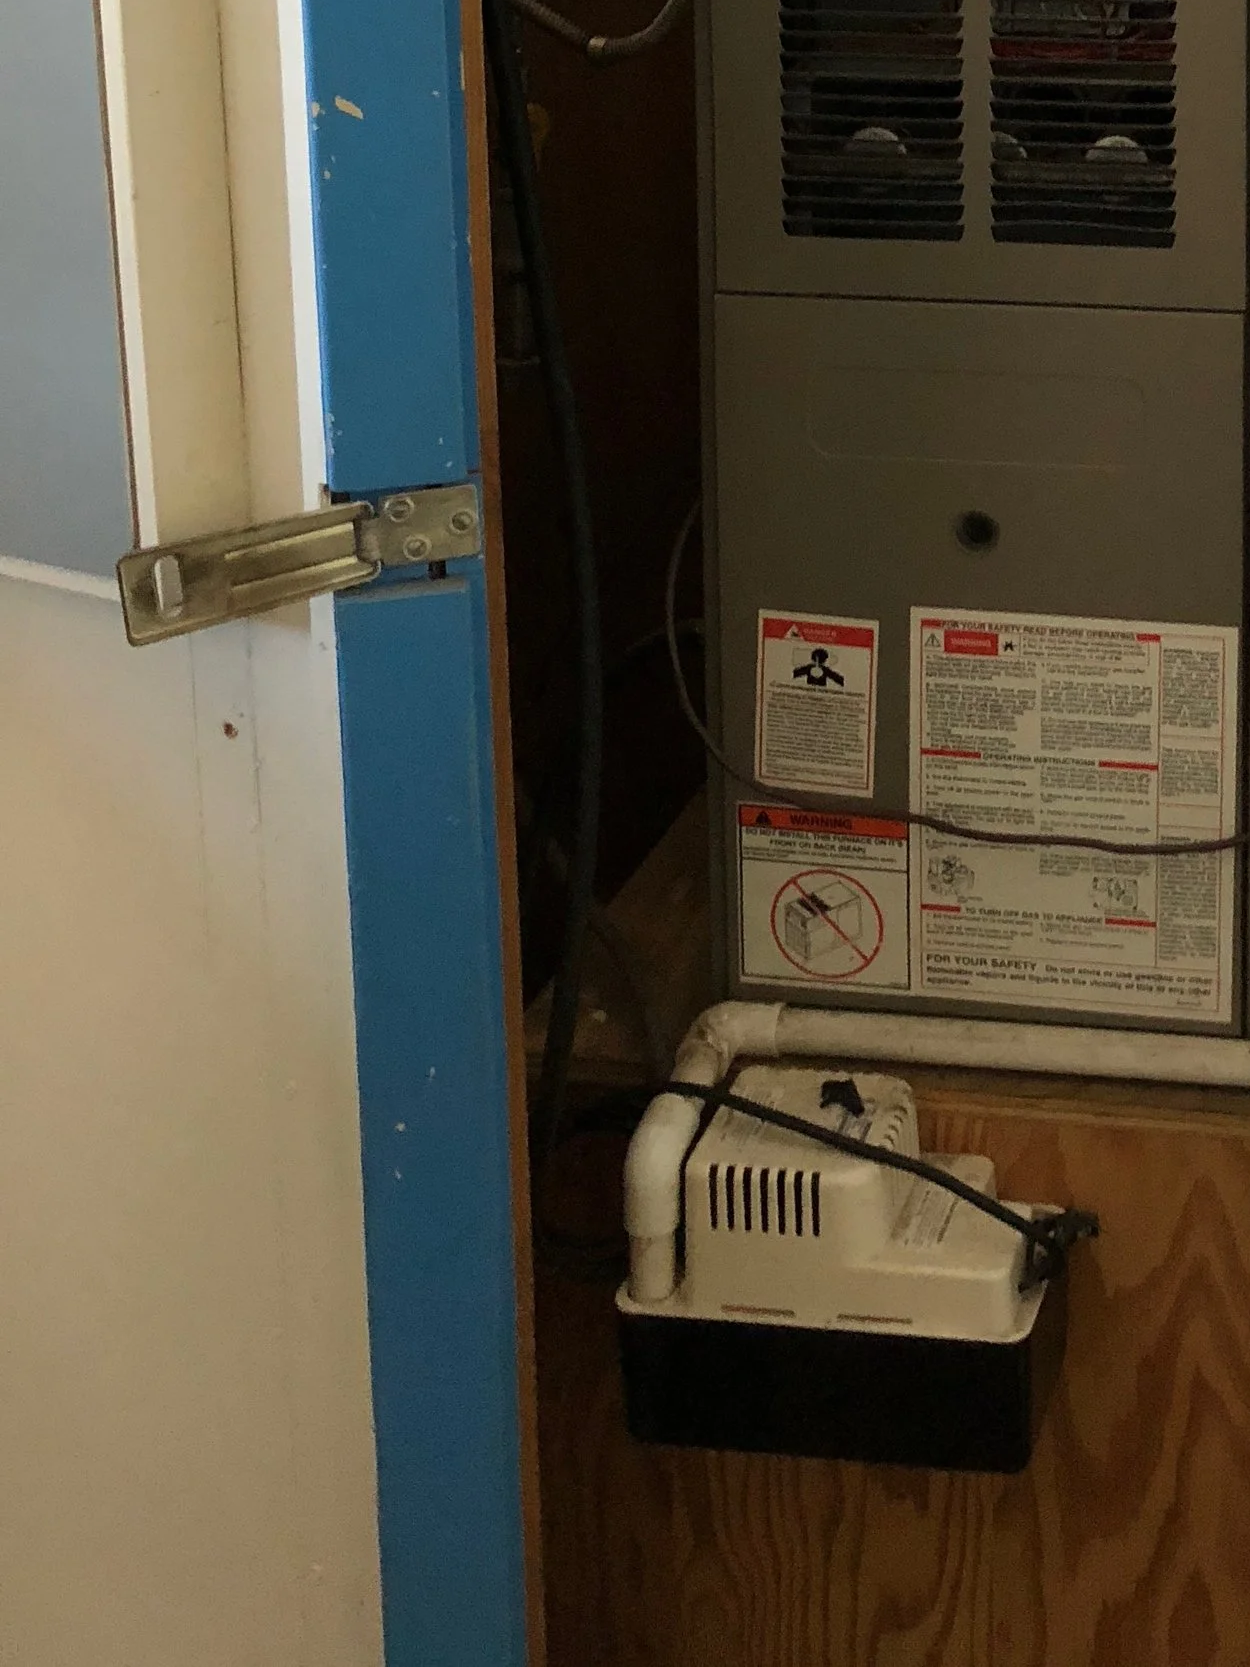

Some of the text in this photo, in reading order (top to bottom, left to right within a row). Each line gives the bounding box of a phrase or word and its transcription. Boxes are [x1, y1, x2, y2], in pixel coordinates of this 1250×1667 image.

[790, 814, 853, 830] WARNING
[926, 953, 950, 962] FOR
[954, 955, 988, 966] YOUR
[990, 958, 1037, 970] SAFETY
